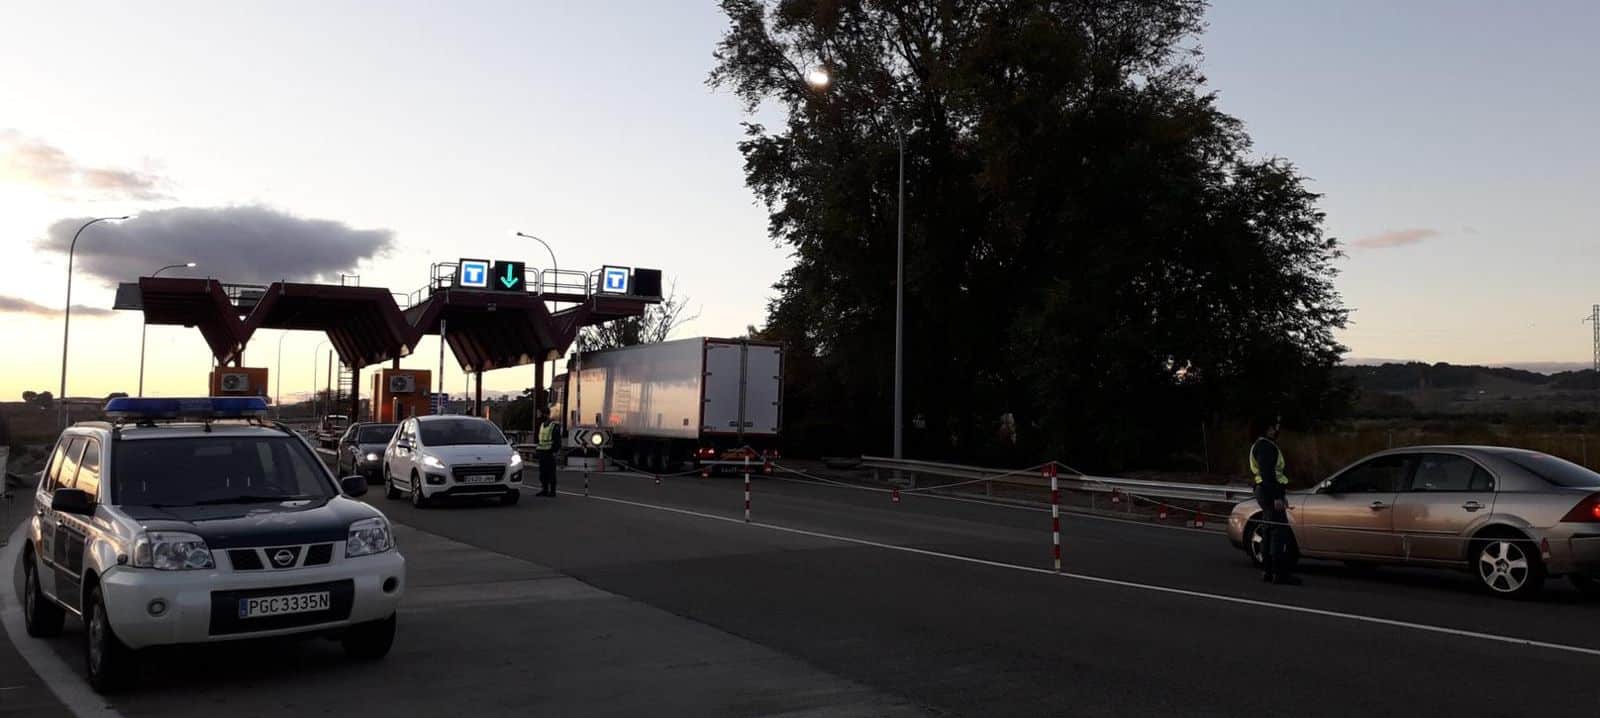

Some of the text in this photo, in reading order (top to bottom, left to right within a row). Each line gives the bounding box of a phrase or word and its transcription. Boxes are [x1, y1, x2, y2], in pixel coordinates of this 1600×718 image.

[467, 268, 482, 282] T
[609, 274, 623, 288] T
[249, 593, 329, 616] PGC3335N
